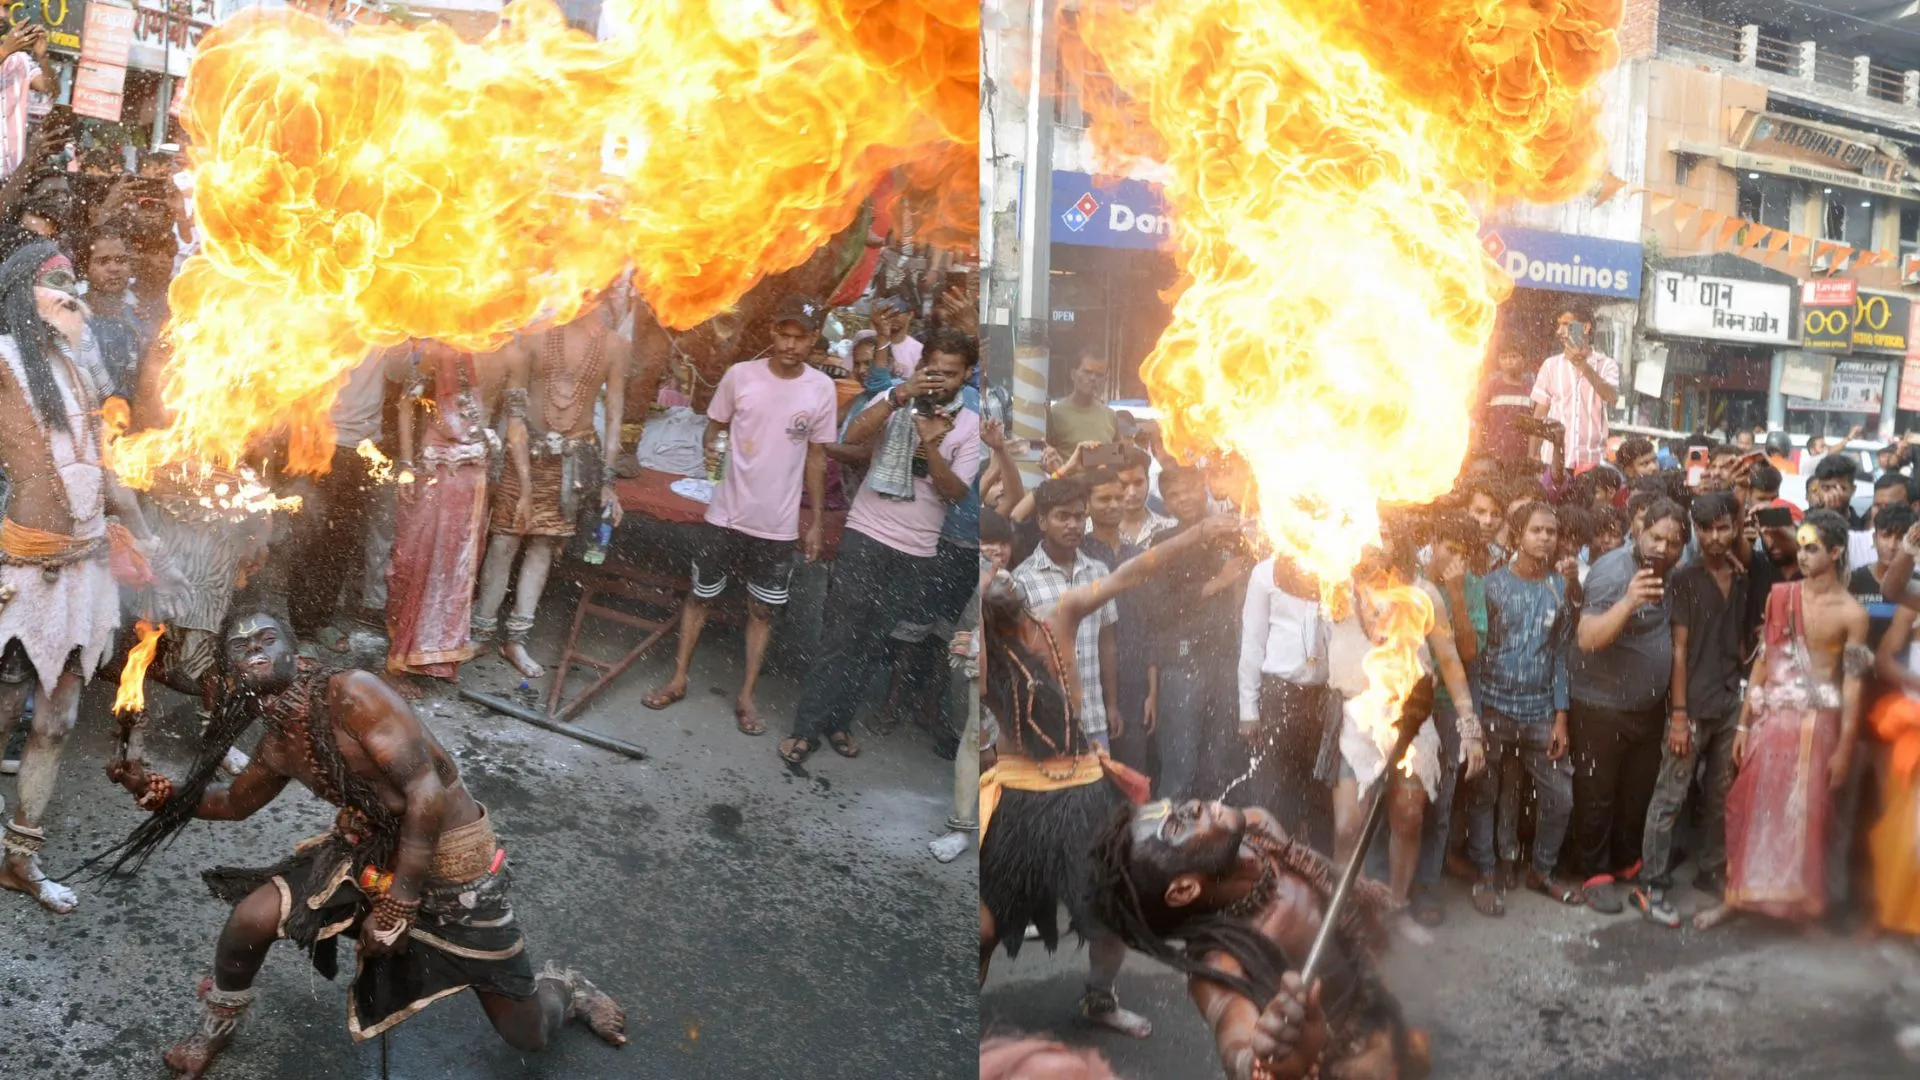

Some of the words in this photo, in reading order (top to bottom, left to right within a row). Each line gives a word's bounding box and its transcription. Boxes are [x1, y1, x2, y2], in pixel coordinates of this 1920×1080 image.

[1505, 251, 1628, 291] Dominos
[1052, 310, 1075, 322] OPEN
[1837, 361, 1887, 372] JEWELLERS
